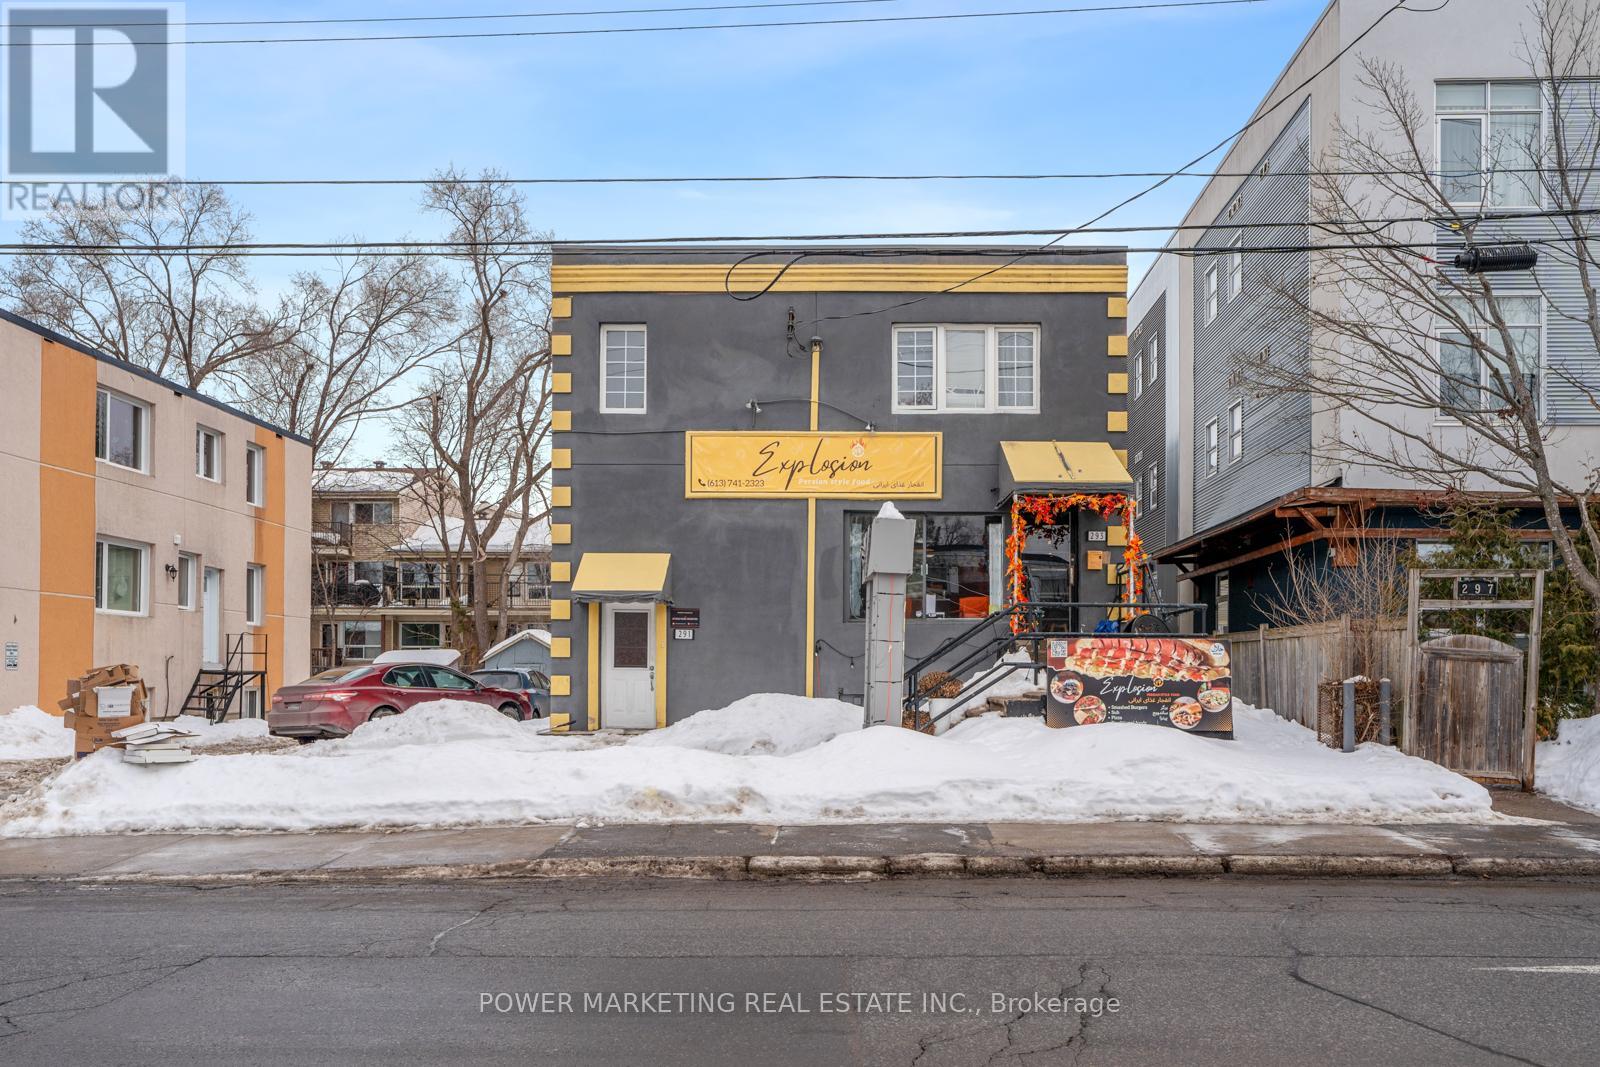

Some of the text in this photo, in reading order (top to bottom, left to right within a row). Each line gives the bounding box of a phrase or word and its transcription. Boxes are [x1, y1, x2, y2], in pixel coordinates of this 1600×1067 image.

[752, 438, 873, 490] Explosion
[707, 479, 765, 488] (613) 741-2323
[1089, 532, 1104, 540] 293
[1461, 583, 1494, 594] 297
[678, 630, 691, 638] 291
[1099, 675, 1158, 701] Explosion
